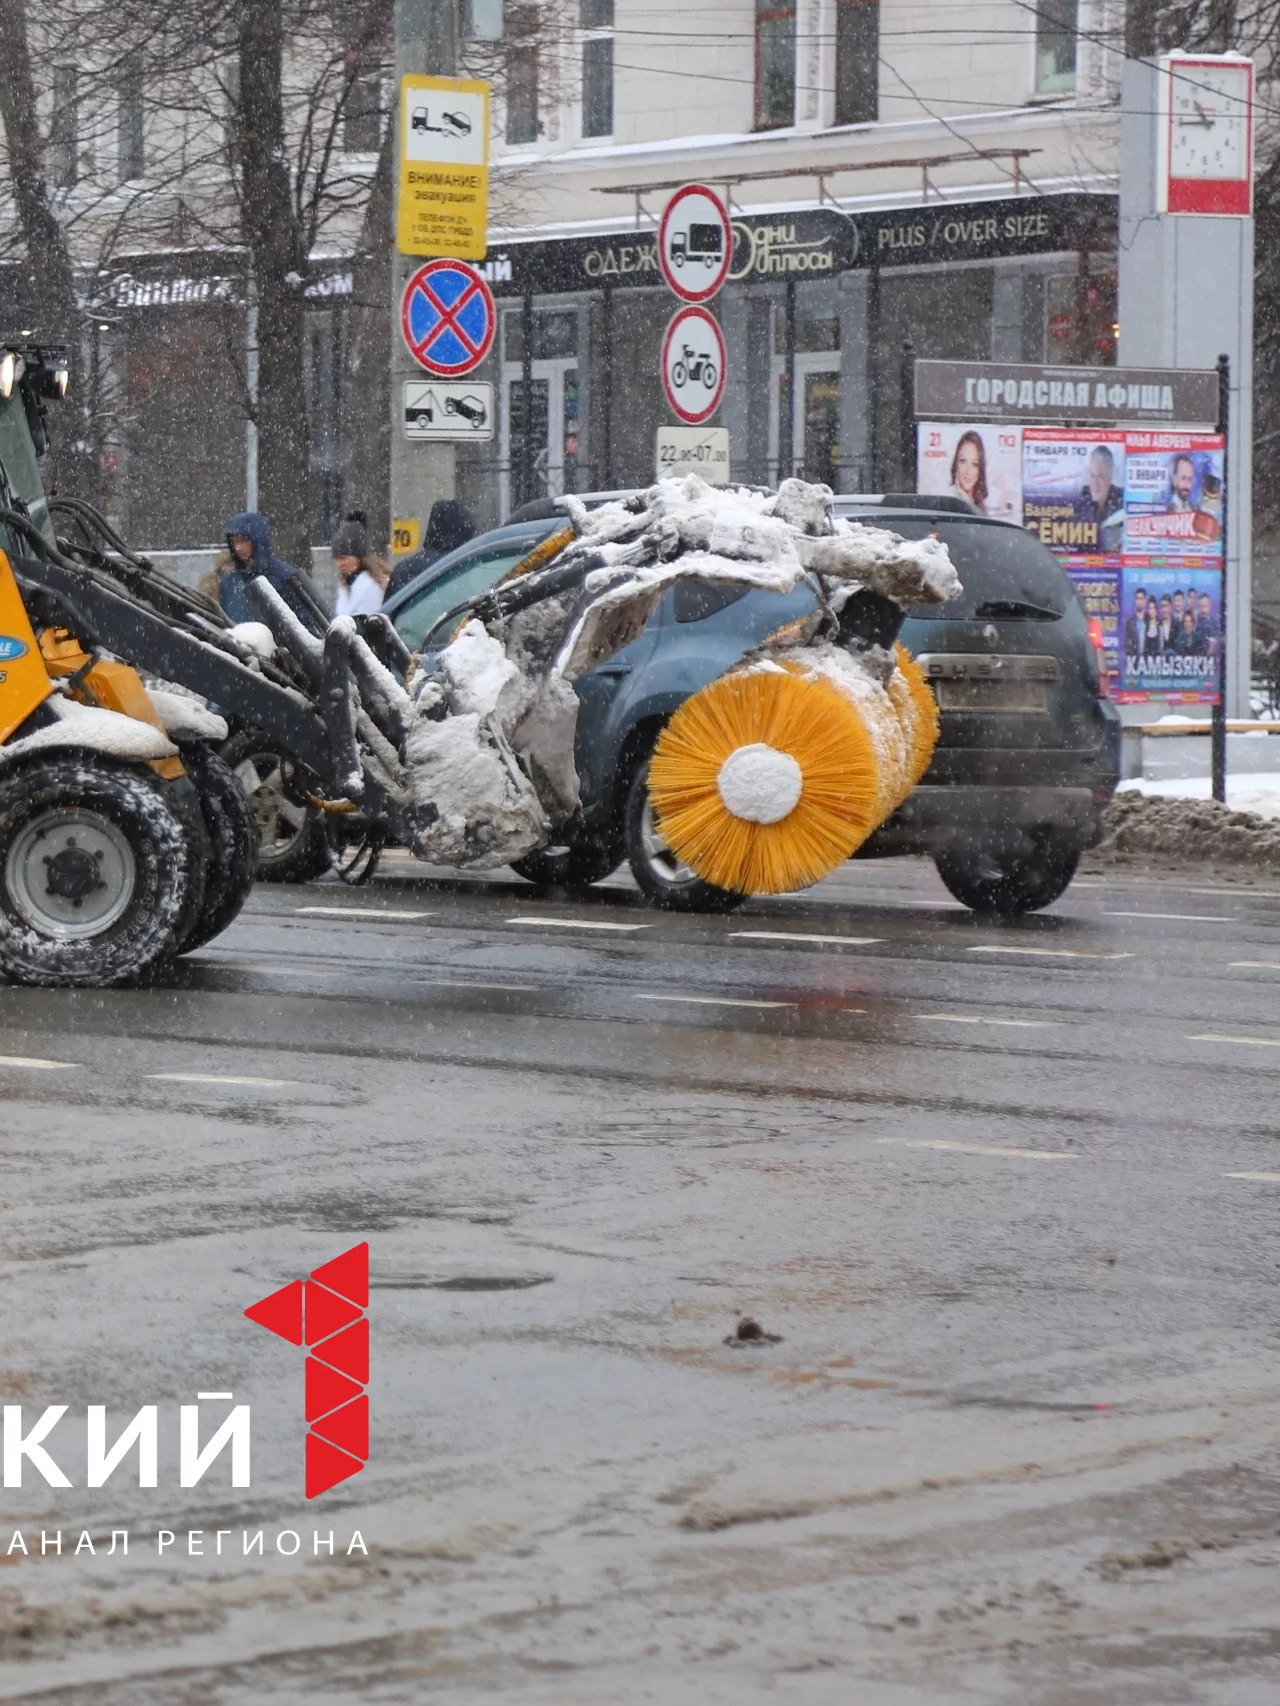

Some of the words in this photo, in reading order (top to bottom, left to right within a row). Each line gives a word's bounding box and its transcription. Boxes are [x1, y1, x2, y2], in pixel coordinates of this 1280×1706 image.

[878, 226, 926, 249] PLUS
[944, 219, 999, 244] OVER
[1004, 214, 1050, 239] SIZE
[583, 245, 660, 277] ОДЕЖ
[965, 377, 1090, 409] ГОРОДСКАЯ
[1094, 382, 1175, 411] АФИША
[393, 529, 411, 548] 70
[1125, 654, 1215, 677] КАМЫЗЯКИ
